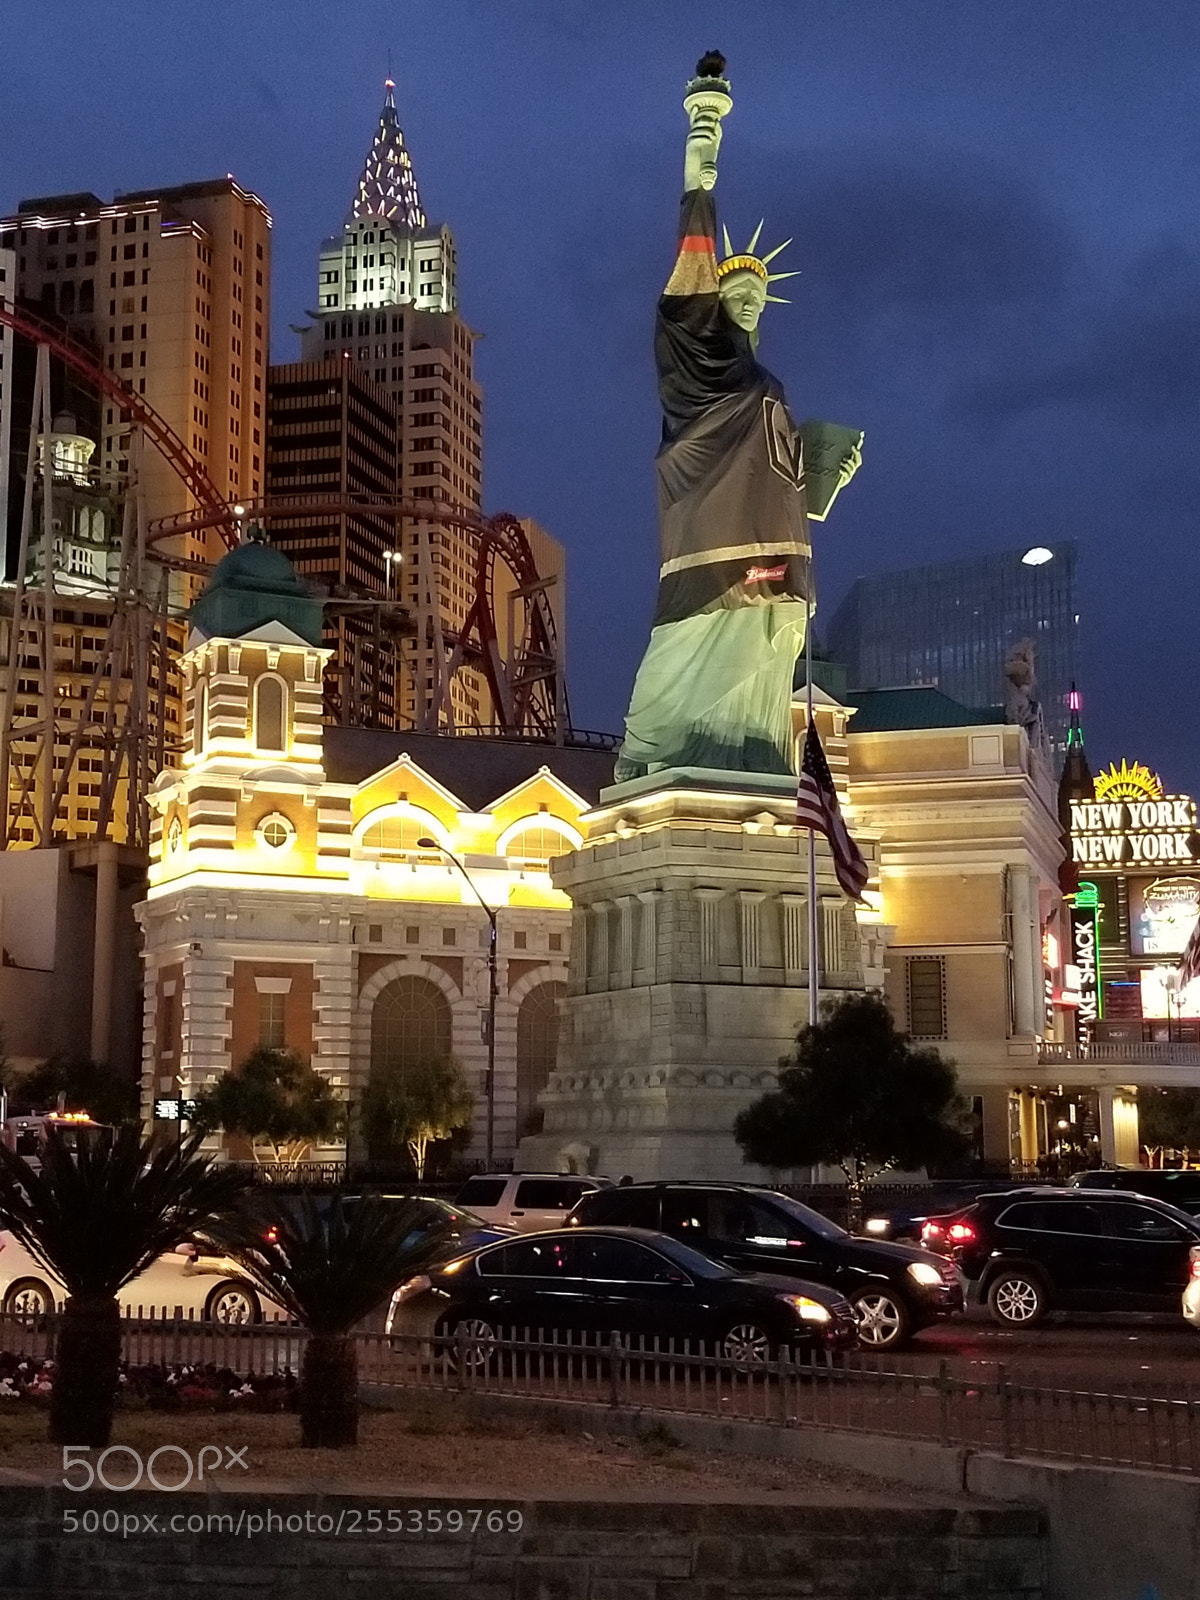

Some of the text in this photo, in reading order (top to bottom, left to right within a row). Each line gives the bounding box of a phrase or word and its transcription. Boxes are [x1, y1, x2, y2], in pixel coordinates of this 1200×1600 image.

[1070, 800, 1191, 831] NEW YORK
[1071, 833, 1193, 862] NEW YORK
[1075, 920, 1096, 985] SHACK
